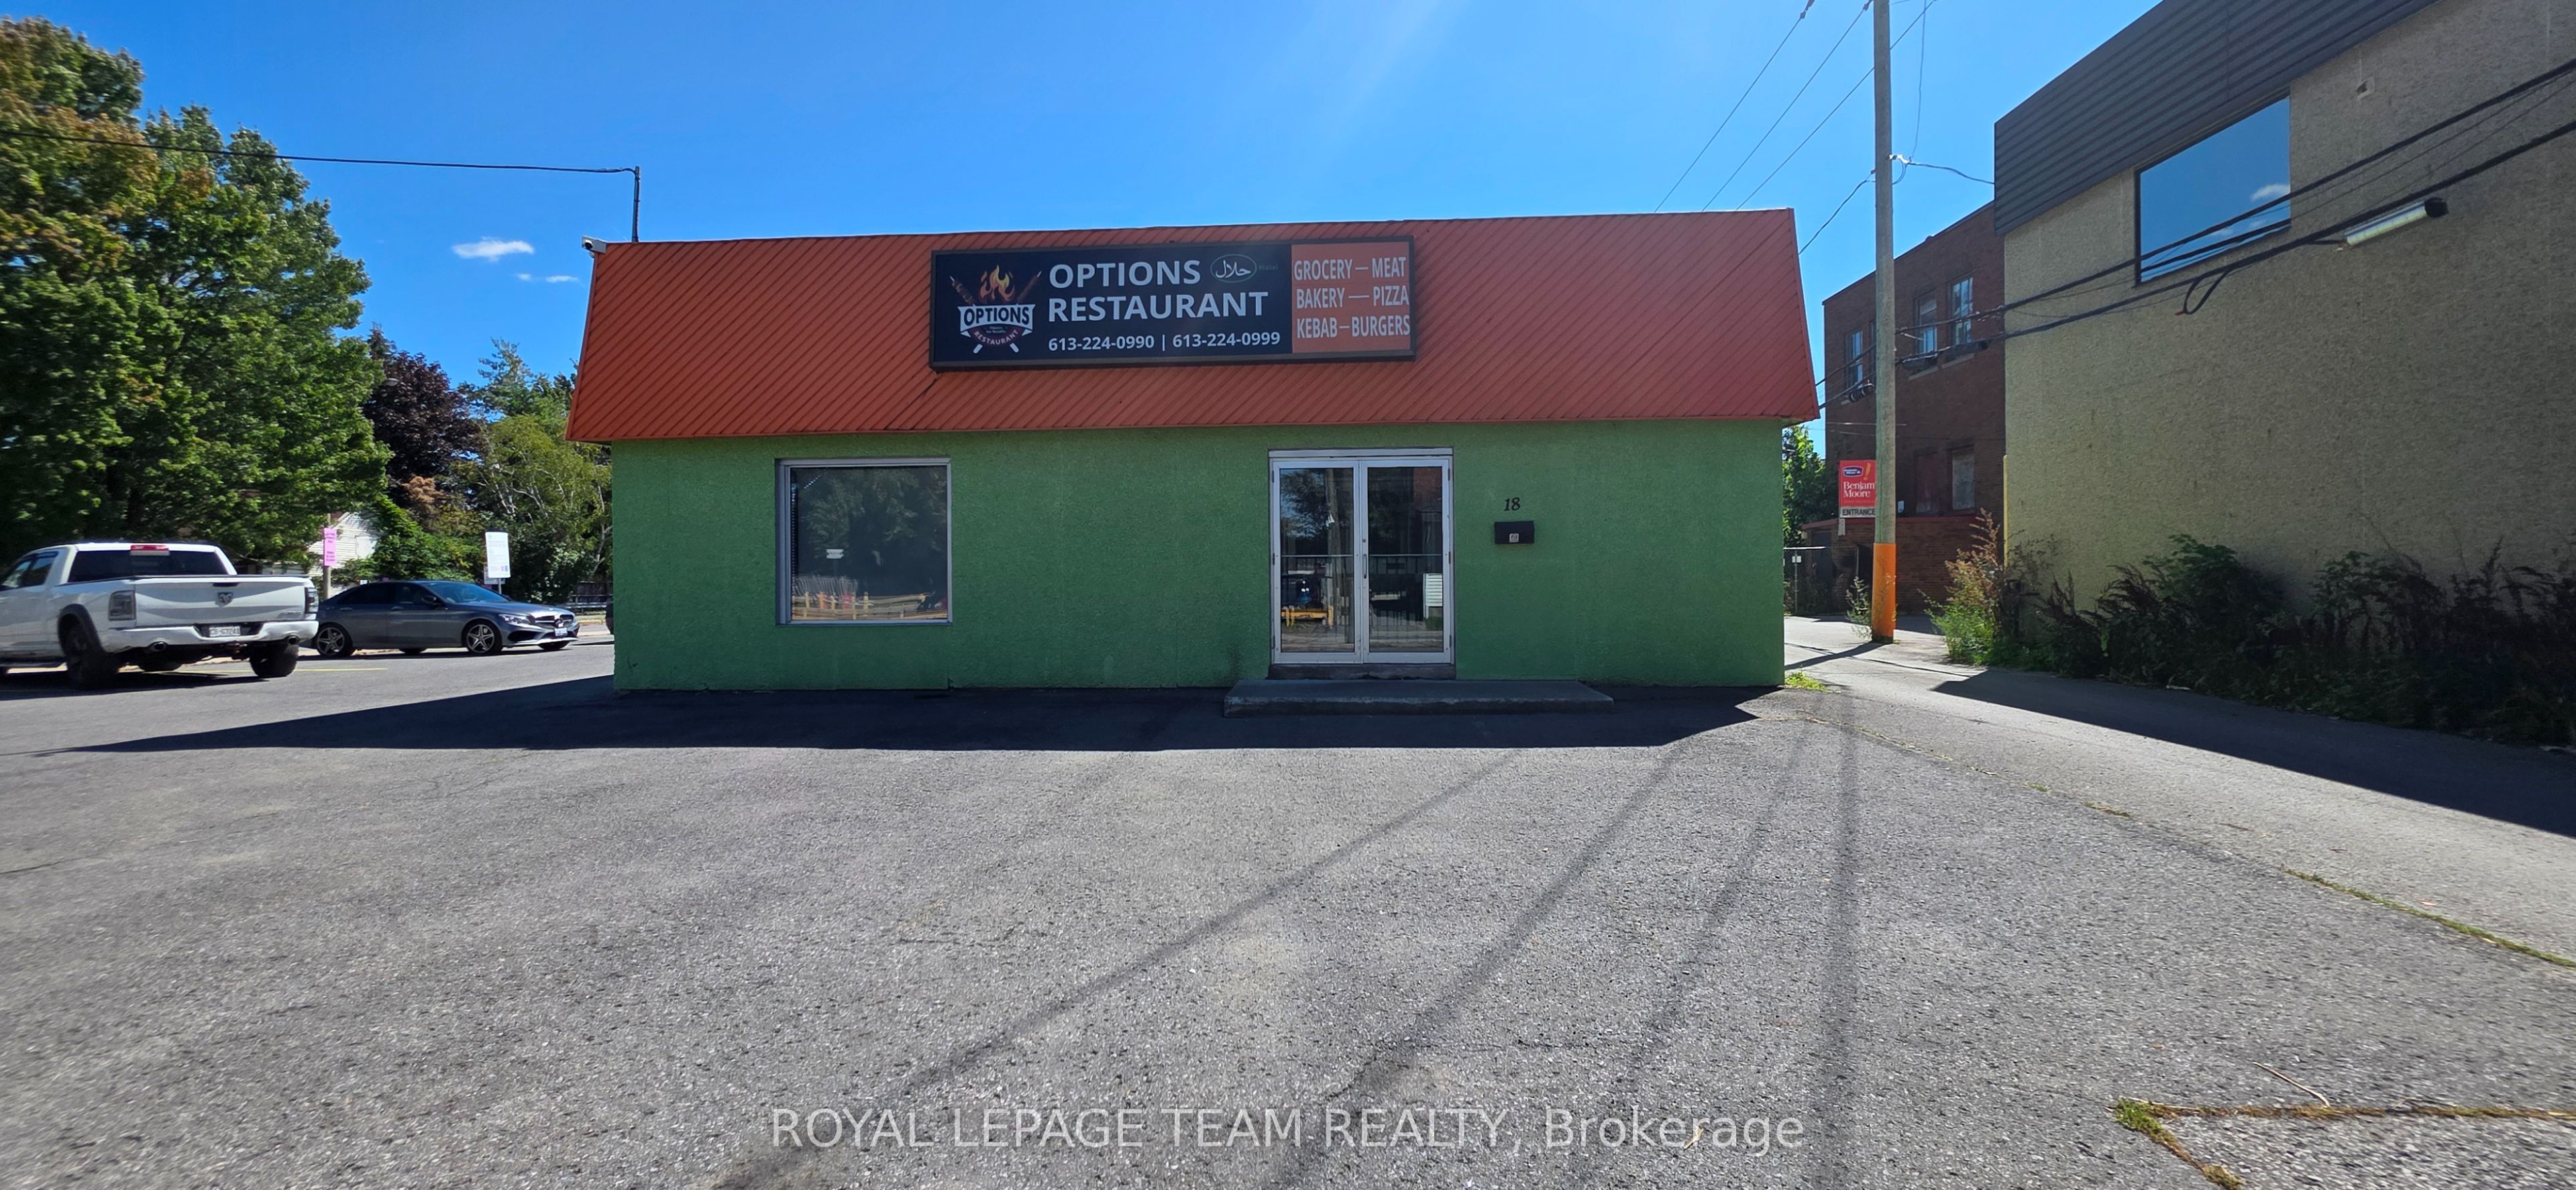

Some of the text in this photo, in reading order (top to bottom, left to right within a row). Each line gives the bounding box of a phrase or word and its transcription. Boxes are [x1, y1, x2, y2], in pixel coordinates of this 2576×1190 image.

[1049, 260, 1201, 288] OPTIONS
[1216, 260, 1251, 278] حلال
[1294, 259, 1352, 280] GROCERY
[1372, 257, 1406, 278] MEAT
[1049, 291, 1269, 322] RESTAURANT
[1297, 288, 1345, 309] BAKERY
[1373, 285, 1409, 307] PIZZA
[964, 307, 1030, 326] OPTIONS
[1297, 317, 1338, 339] KEBAB
[1352, 315, 1410, 337] BURGERS
[974, 329, 1018, 345] RESTAURANT
[1049, 335, 1155, 351] 613-224-0990
[1173, 331, 1281, 347] 613-224-0999
[1843, 481, 1876, 490] Benjam
[1843, 490, 1871, 498] Moore
[1503, 496, 1521, 511] 18
